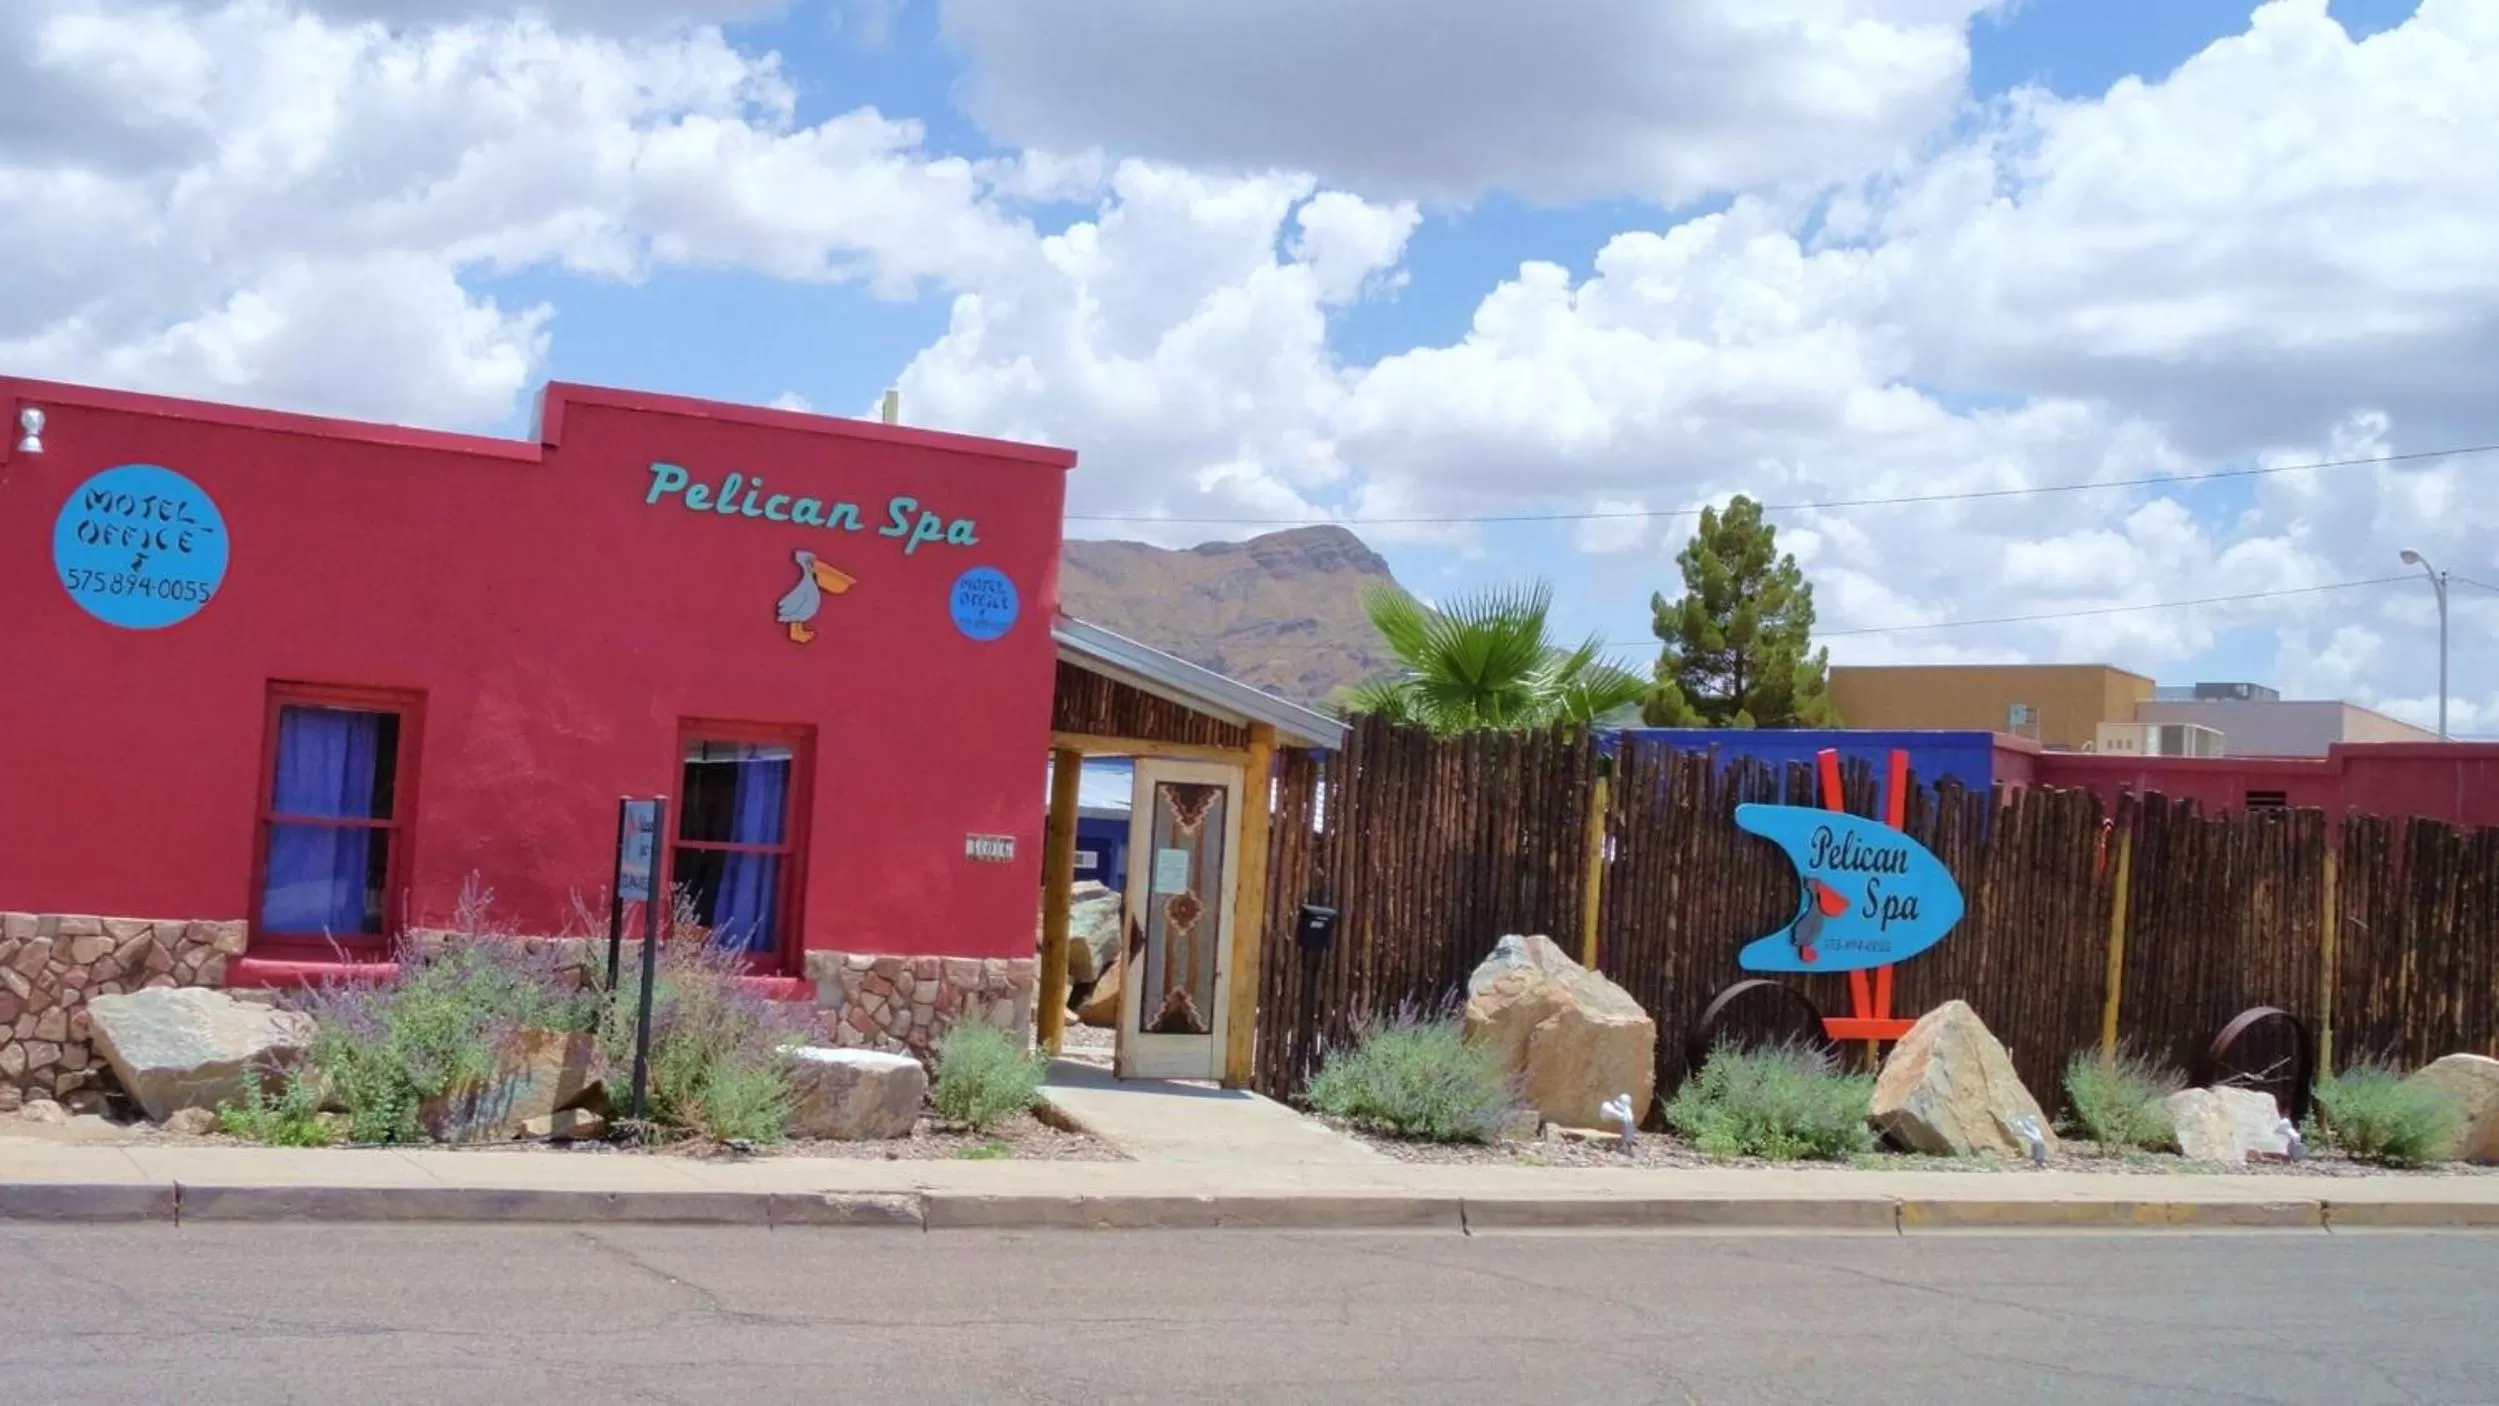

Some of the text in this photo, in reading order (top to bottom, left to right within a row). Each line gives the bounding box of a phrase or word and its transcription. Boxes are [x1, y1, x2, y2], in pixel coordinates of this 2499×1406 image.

[85, 488, 197, 525] MOTEL
[645, 461, 981, 556] Pelican Spa
[77, 519, 194, 554] OFFICE
[1809, 825, 1908, 875] Pelican
[1862, 877, 1920, 932] Spa
